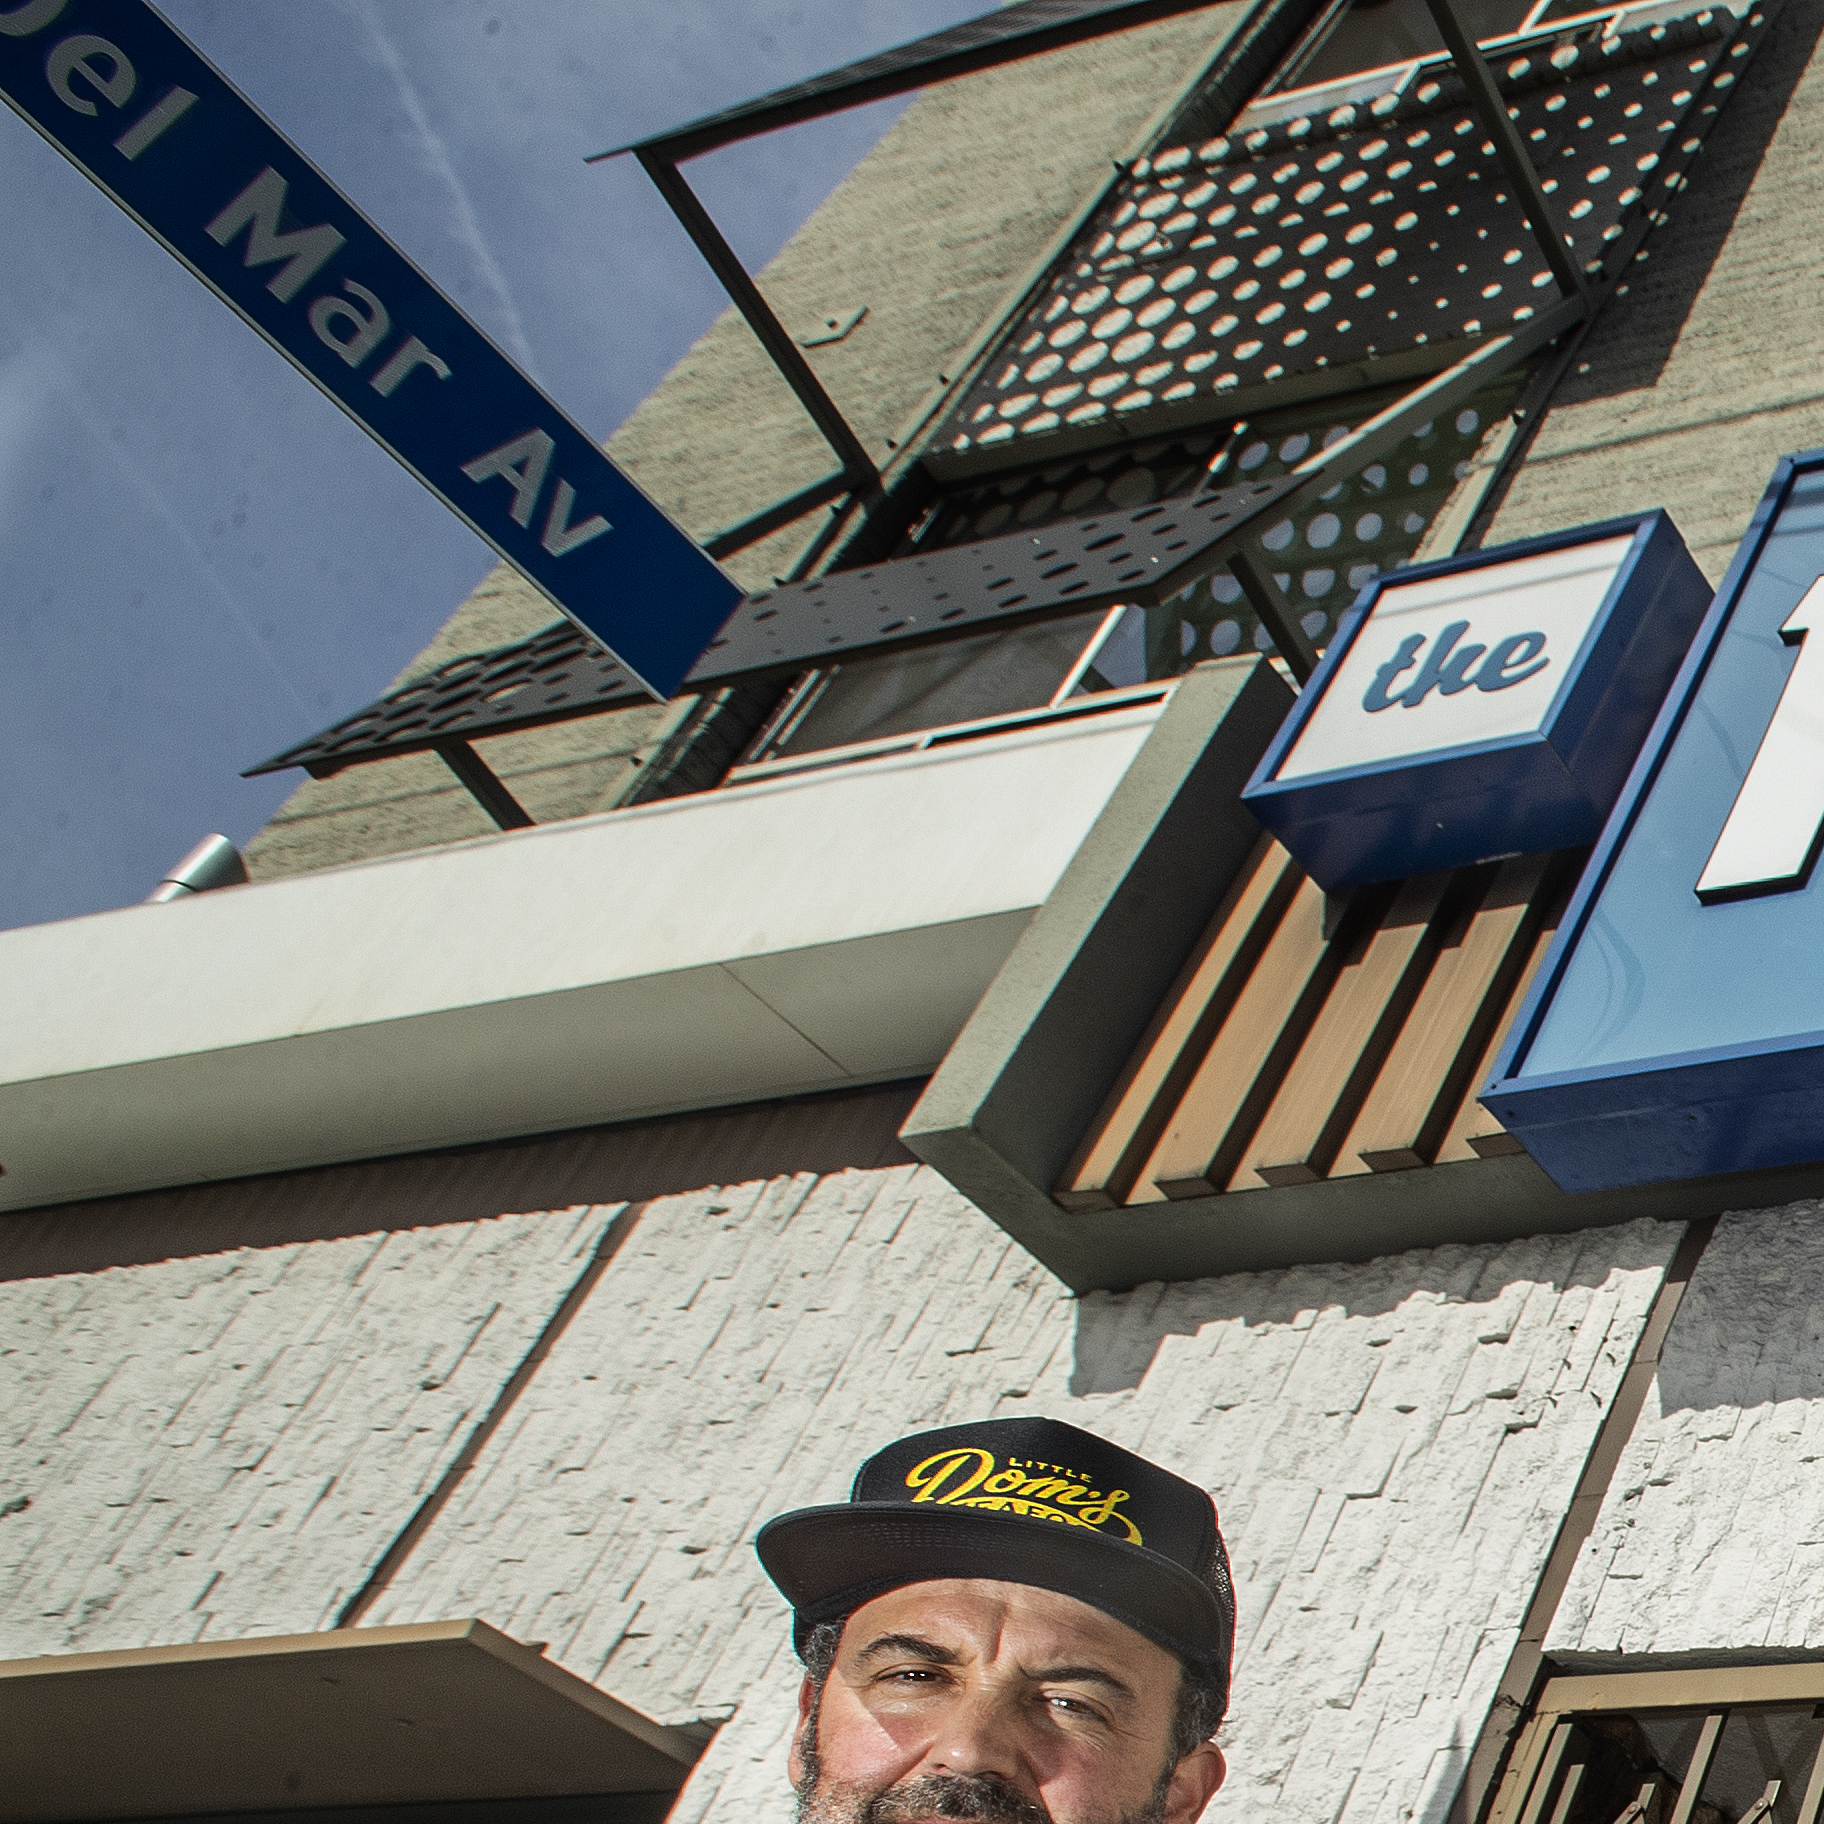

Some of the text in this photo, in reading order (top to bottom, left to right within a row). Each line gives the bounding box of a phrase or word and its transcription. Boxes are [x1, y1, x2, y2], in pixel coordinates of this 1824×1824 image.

[0, 0, 614, 558] el Mar Av
[1361, 619, 1549, 714] the
[905, 1447, 1142, 1546] Dom's
[1008, 1457, 1092, 1483] LITTLE
